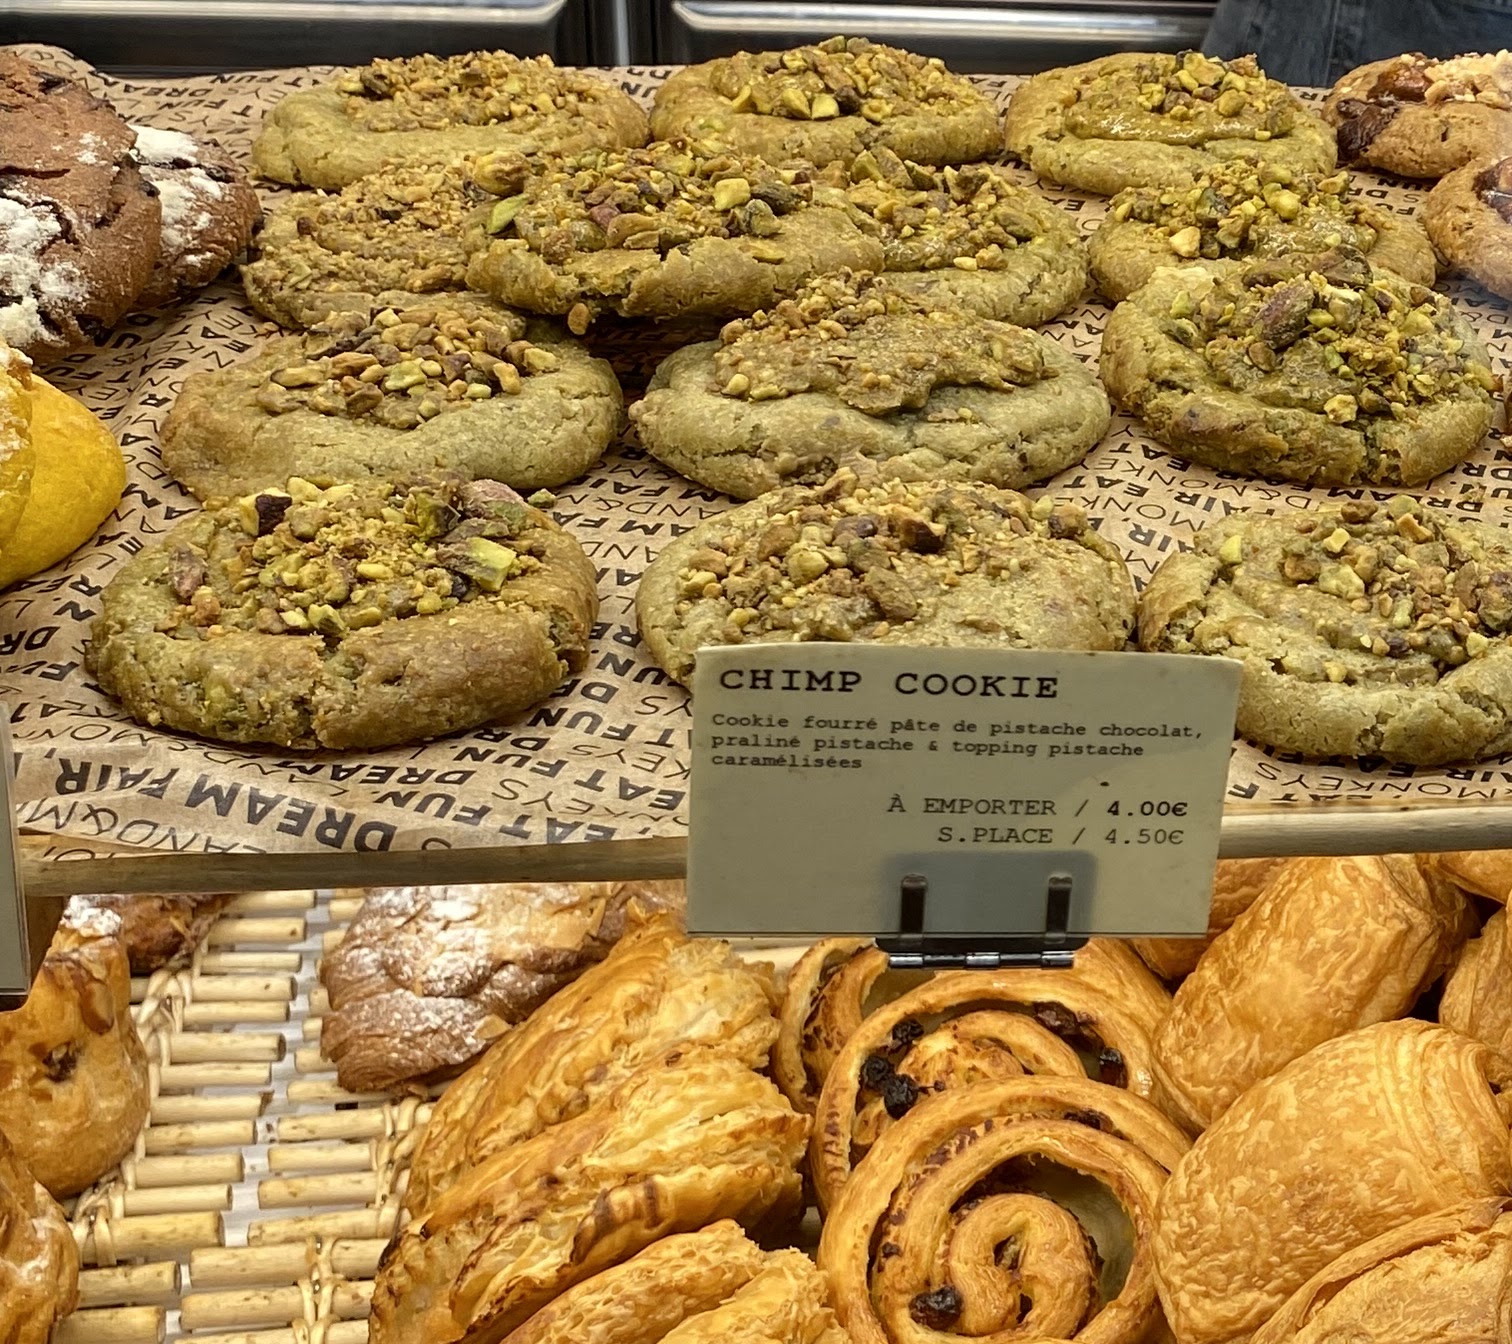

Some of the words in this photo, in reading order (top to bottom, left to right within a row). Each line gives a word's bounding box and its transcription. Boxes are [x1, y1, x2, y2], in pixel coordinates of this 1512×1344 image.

[1109, 444, 1192, 472] EAT
[1063, 476, 1149, 498] EAT
[720, 668, 862, 693] CHIMP
[895, 672, 1059, 699] COOKIE
[712, 713, 789, 730] Cookie
[803, 714, 877, 731] fourré
[891, 716, 940, 734] pâte
[953, 719, 977, 734] de
[990, 720, 1087, 737] pistache
[1100, 723, 1203, 740] chocolat,
[711, 734, 800, 751] praliné
[814, 737, 913, 754] pistache
[927, 740, 939, 752] &
[952, 740, 1037, 758] topping
[1049, 741, 1144, 758] pistache
[449, 747, 568, 778] FUN.
[711, 752, 863, 770] caramélisées
[45, 749, 180, 799] FAIR,
[185, 774, 397, 853] DREAM
[574, 770, 685, 811] EAT
[371, 791, 492, 827] FUN.
[887, 794, 906, 814] À
[923, 798, 1057, 817] EMPORTER
[1074, 798, 1090, 817] /
[1106, 800, 1188, 818] 4.00€
[937, 826, 1053, 845] S.PLACE
[1072, 827, 1085, 846] /
[1105, 827, 1185, 846] 4.50€
